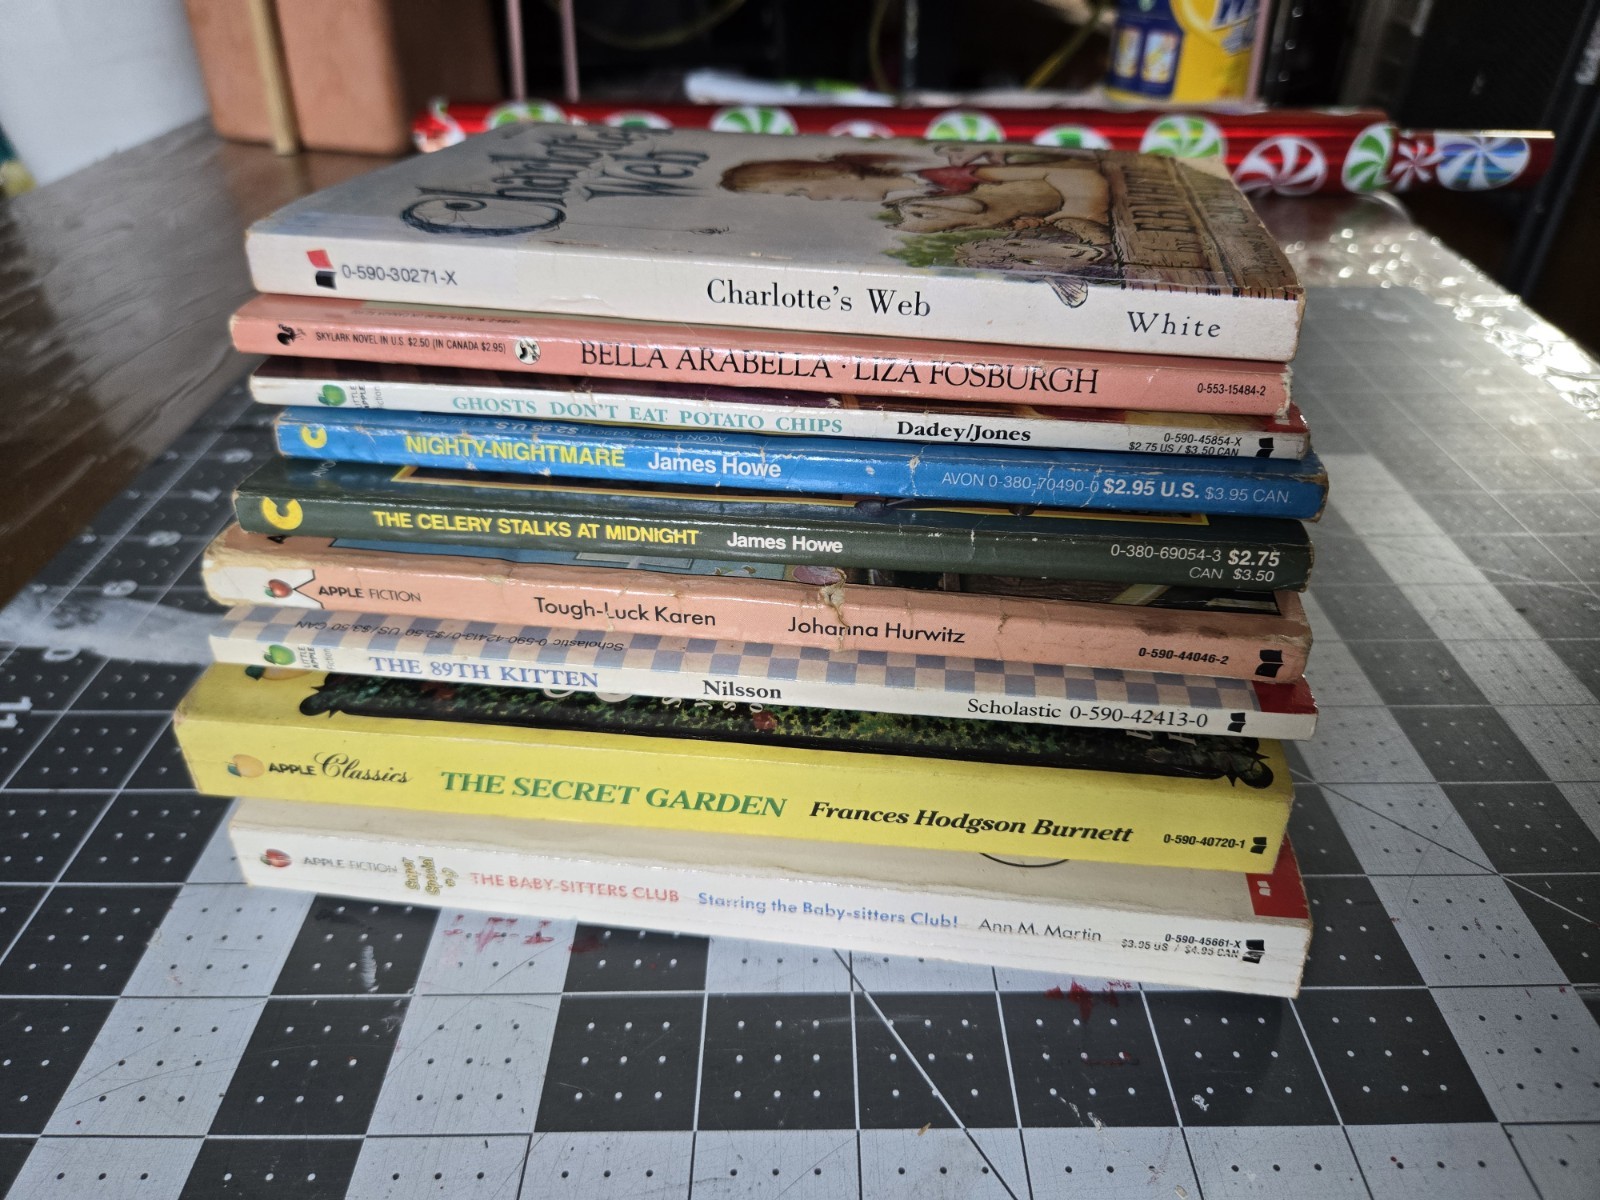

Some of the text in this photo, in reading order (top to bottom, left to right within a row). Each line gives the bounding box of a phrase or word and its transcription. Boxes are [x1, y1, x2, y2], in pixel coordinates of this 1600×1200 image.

[583, 150, 709, 200] Web
[342, 265, 458, 286] 0-590-30271-X
[707, 278, 931, 317] Charlotte's Web
[1127, 311, 1221, 338] White
[316, 332, 506, 354] SKYLARK NOVEL IN U.S. $2.50 (IN CANADA $2.95)
[580, 340, 1100, 394] BELLA ARABELLA LIZA FOSBURGH
[1197, 383, 1266, 396] 0-553-15484-2
[452, 396, 843, 433] GHOSTS DON'T EAT POTATO CHIPS
[897, 421, 1032, 442] Dadey/Jones
[1163, 433, 1242, 446] 0-590-45854-X
[406, 435, 782, 478] NIGHTY-NIGHTMARE James Howe
[1160, 442, 1174, 453] US
[1217, 447, 1239, 457] CAN
[941, 472, 985, 487] AVON
[988, 475, 1100, 493] 0-380-70490-0
[1103, 478, 1156, 496] $2.95
[1160, 481, 1200, 499] U.S.
[1205, 486, 1249, 501] $3.95
[372, 510, 844, 553] THE CELERY STALKS AT MIDNIGHT James Howe
[1110, 543, 1280, 567] 0-380-69054-3 $2.75
[1189, 566, 1275, 583] CAN $3.50
[318, 585, 422, 603] APPLE FICTION
[533, 596, 717, 626] Tough-Luck Karen
[295, 621, 328, 631] CAN
[787, 616, 966, 644] Johanna Hurwitz
[553, 638, 624, 651] Scholastic
[1138, 647, 1230, 666] 0-590-44046-2
[369, 656, 599, 688] THE 89TH KITTEN
[702, 679, 782, 700] Nilsson
[967, 698, 1208, 728] Scholastic 0-590-42413-0
[268, 751, 413, 783] APPLE Classics
[441, 771, 788, 817] THE SECRET GARDEN
[809, 801, 1134, 842] Frances Hodgson Burnett
[1164, 834, 1245, 849] 0-590-40720-1
[303, 856, 397, 873] APPLE FICTION
[470, 872, 679, 902] THE BABY-SITTERS CLUB
[698, 892, 958, 928] Starring the Baby-sitters Club!
[979, 918, 1102, 942] Ann M. Martin
[1164, 933, 1242, 949] 0-590-45661-X
